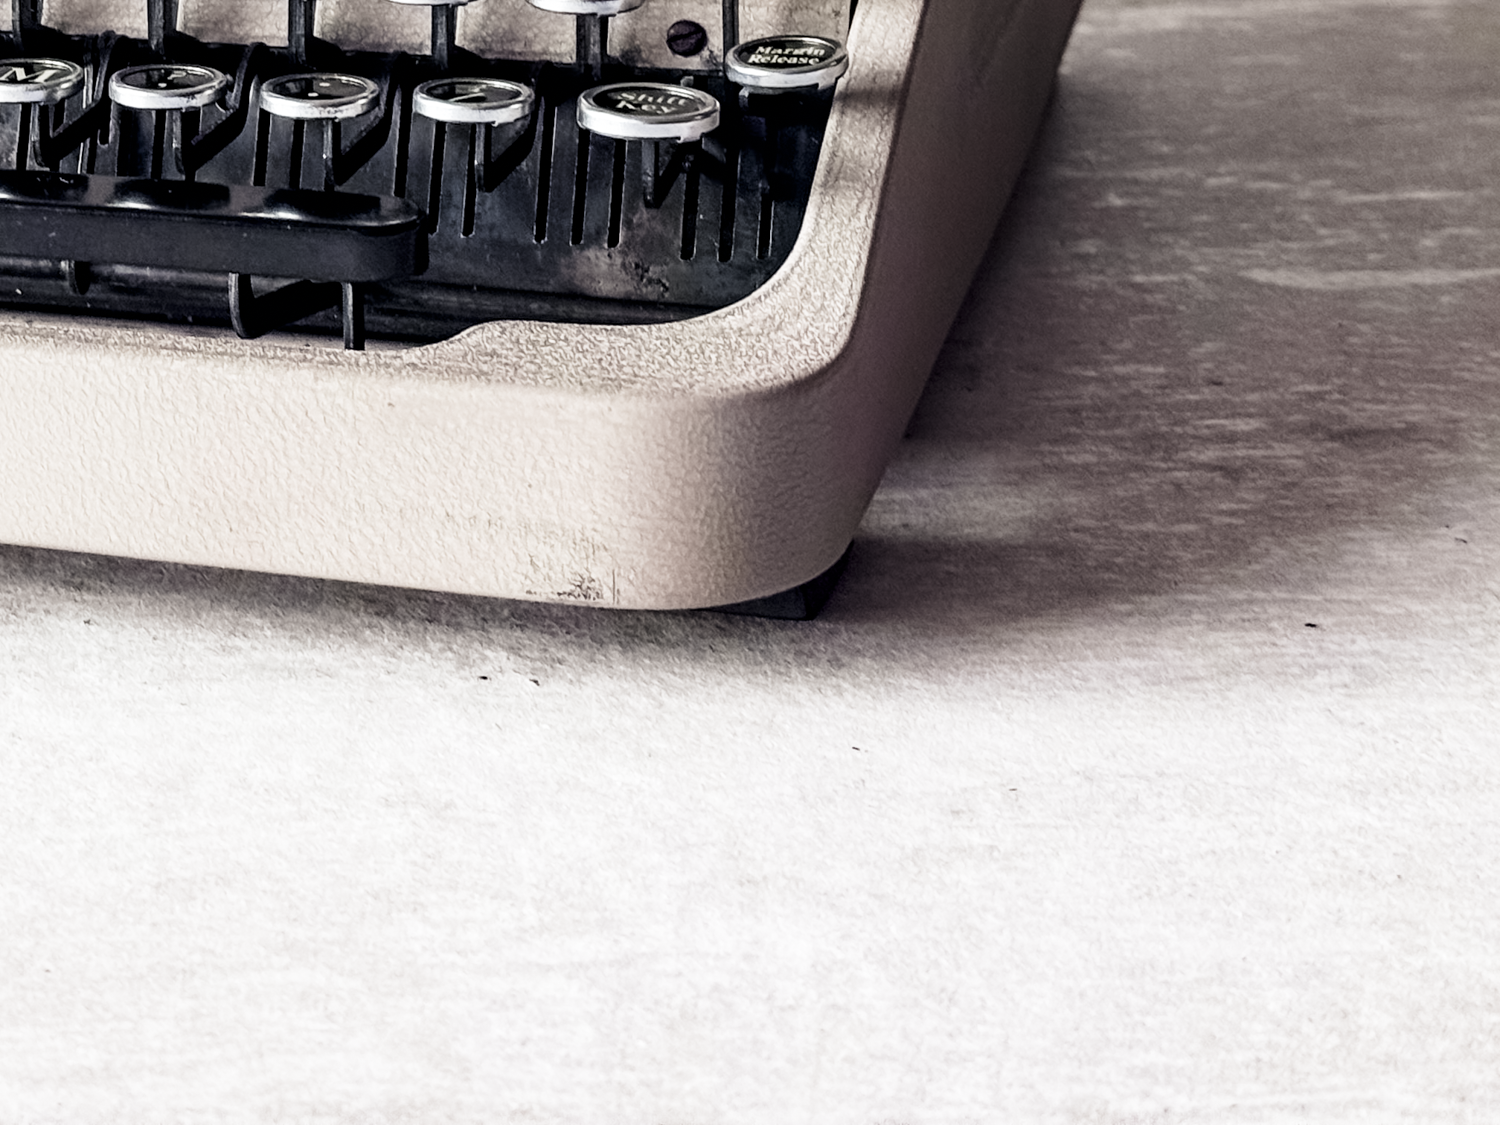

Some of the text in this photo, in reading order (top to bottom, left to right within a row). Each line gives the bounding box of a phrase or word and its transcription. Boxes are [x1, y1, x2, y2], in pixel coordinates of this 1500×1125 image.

[746, 53, 821, 66] Release
[617, 91, 690, 107] Shift
[614, 101, 671, 116] Key
